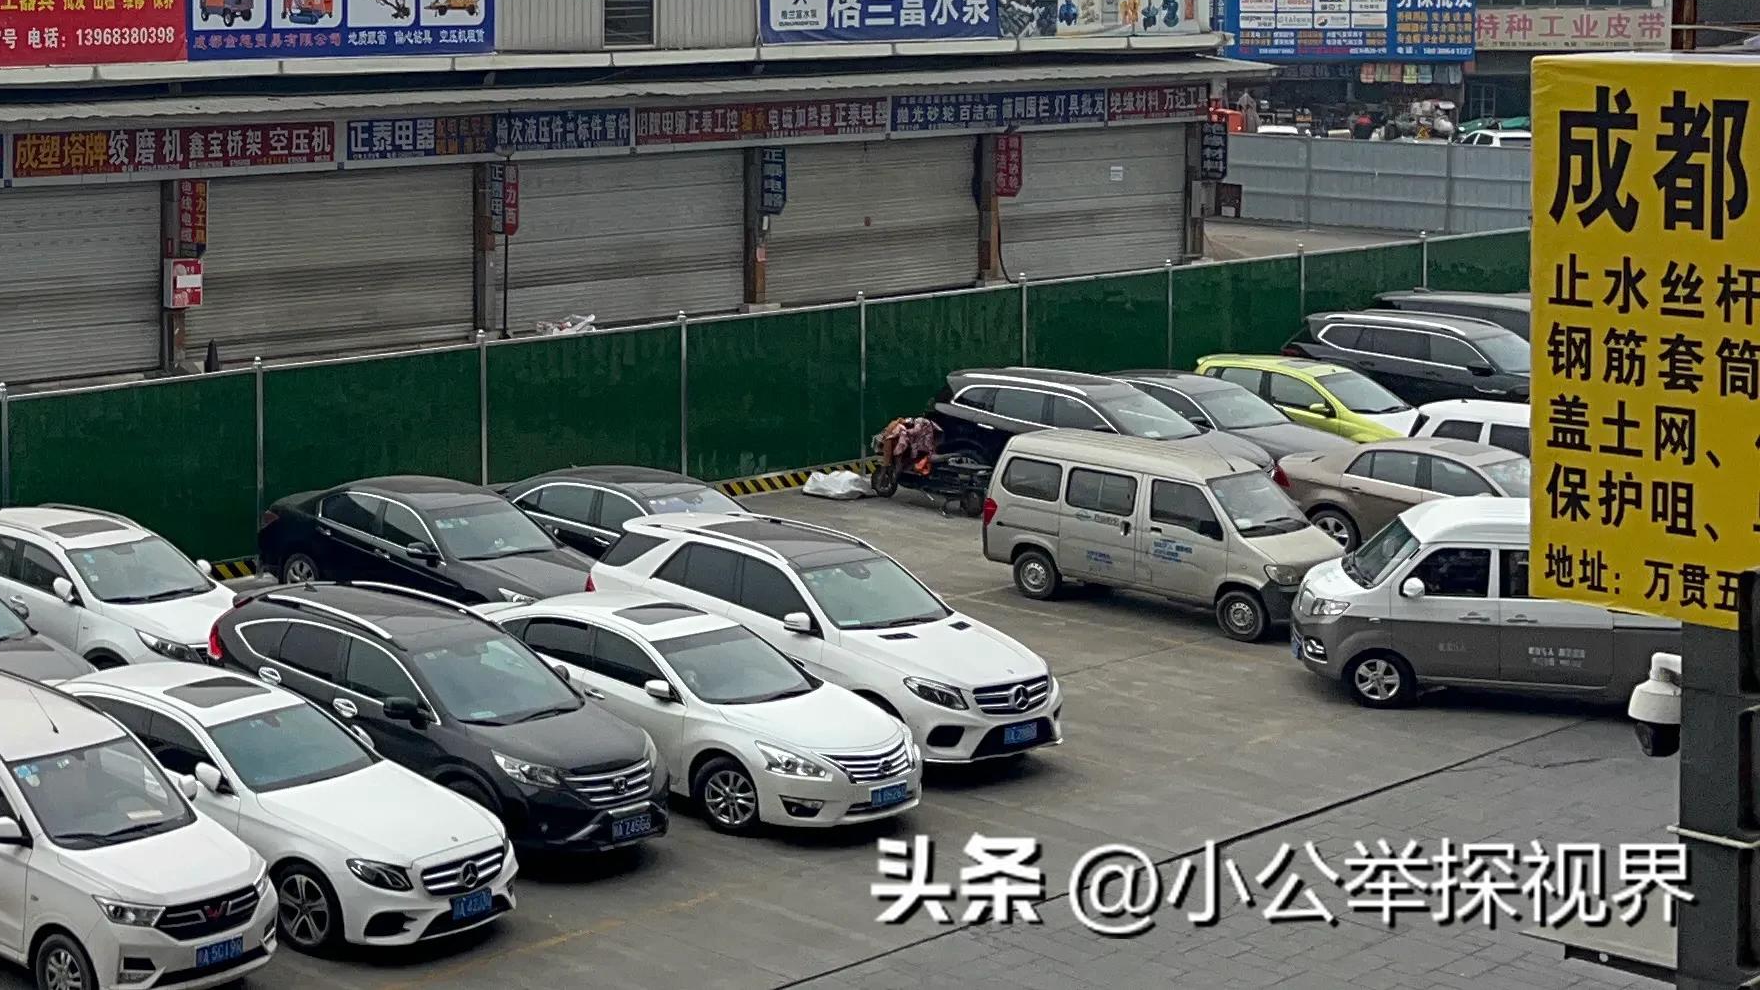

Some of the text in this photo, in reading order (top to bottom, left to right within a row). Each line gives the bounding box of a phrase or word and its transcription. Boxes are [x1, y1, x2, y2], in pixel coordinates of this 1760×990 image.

[76, 26, 175, 47] 13968380398
[1475, 12, 1666, 41] 特种工业皮带
[108, 128, 183, 165] 绞磨机
[189, 126, 330, 159] 鑫宝桥架 空压机
[350, 118, 435, 153] 正泰电器
[1549, 85, 1750, 240] 成都
[1548, 253, 1760, 326] 止水丝杆
[1548, 321, 1760, 400] 钢筋套筒
[1547, 393, 1760, 468] 盖土网、
[1546, 462, 1760, 542] 保护咀、
